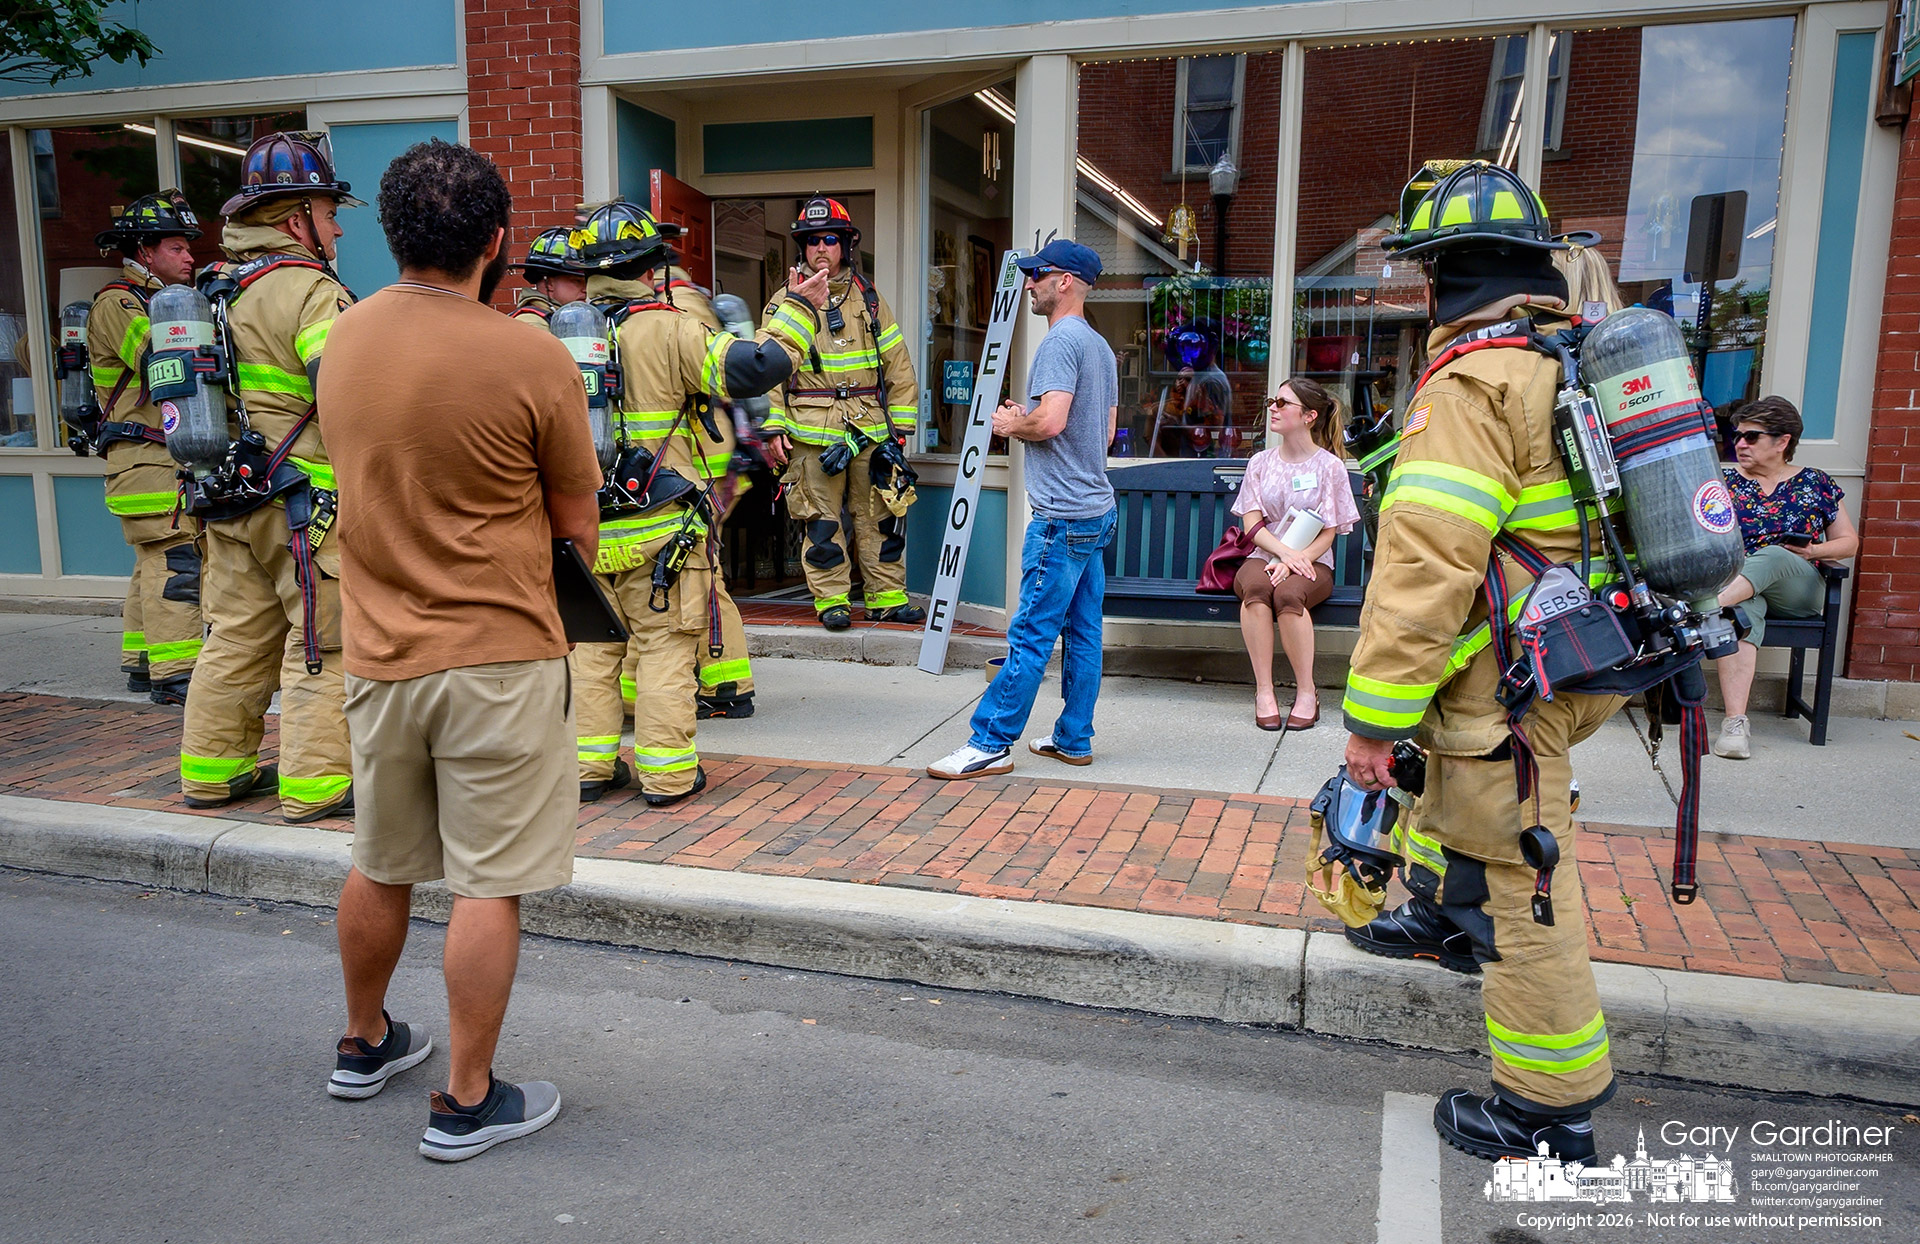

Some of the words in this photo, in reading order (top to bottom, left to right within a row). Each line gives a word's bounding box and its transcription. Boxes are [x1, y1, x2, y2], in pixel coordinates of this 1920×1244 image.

[238, 259, 264, 275] 3M
[66, 330, 78, 338] 3M
[168, 326, 187, 336] 3M
[592, 342, 606, 353] 3M
[945, 364, 960, 380] Come
[945, 386, 970, 401] OPEN
[1621, 375, 1652, 397] 3M
[1628, 389, 1665, 408] SCOTT
[929, 288, 1019, 634] WELCOME
